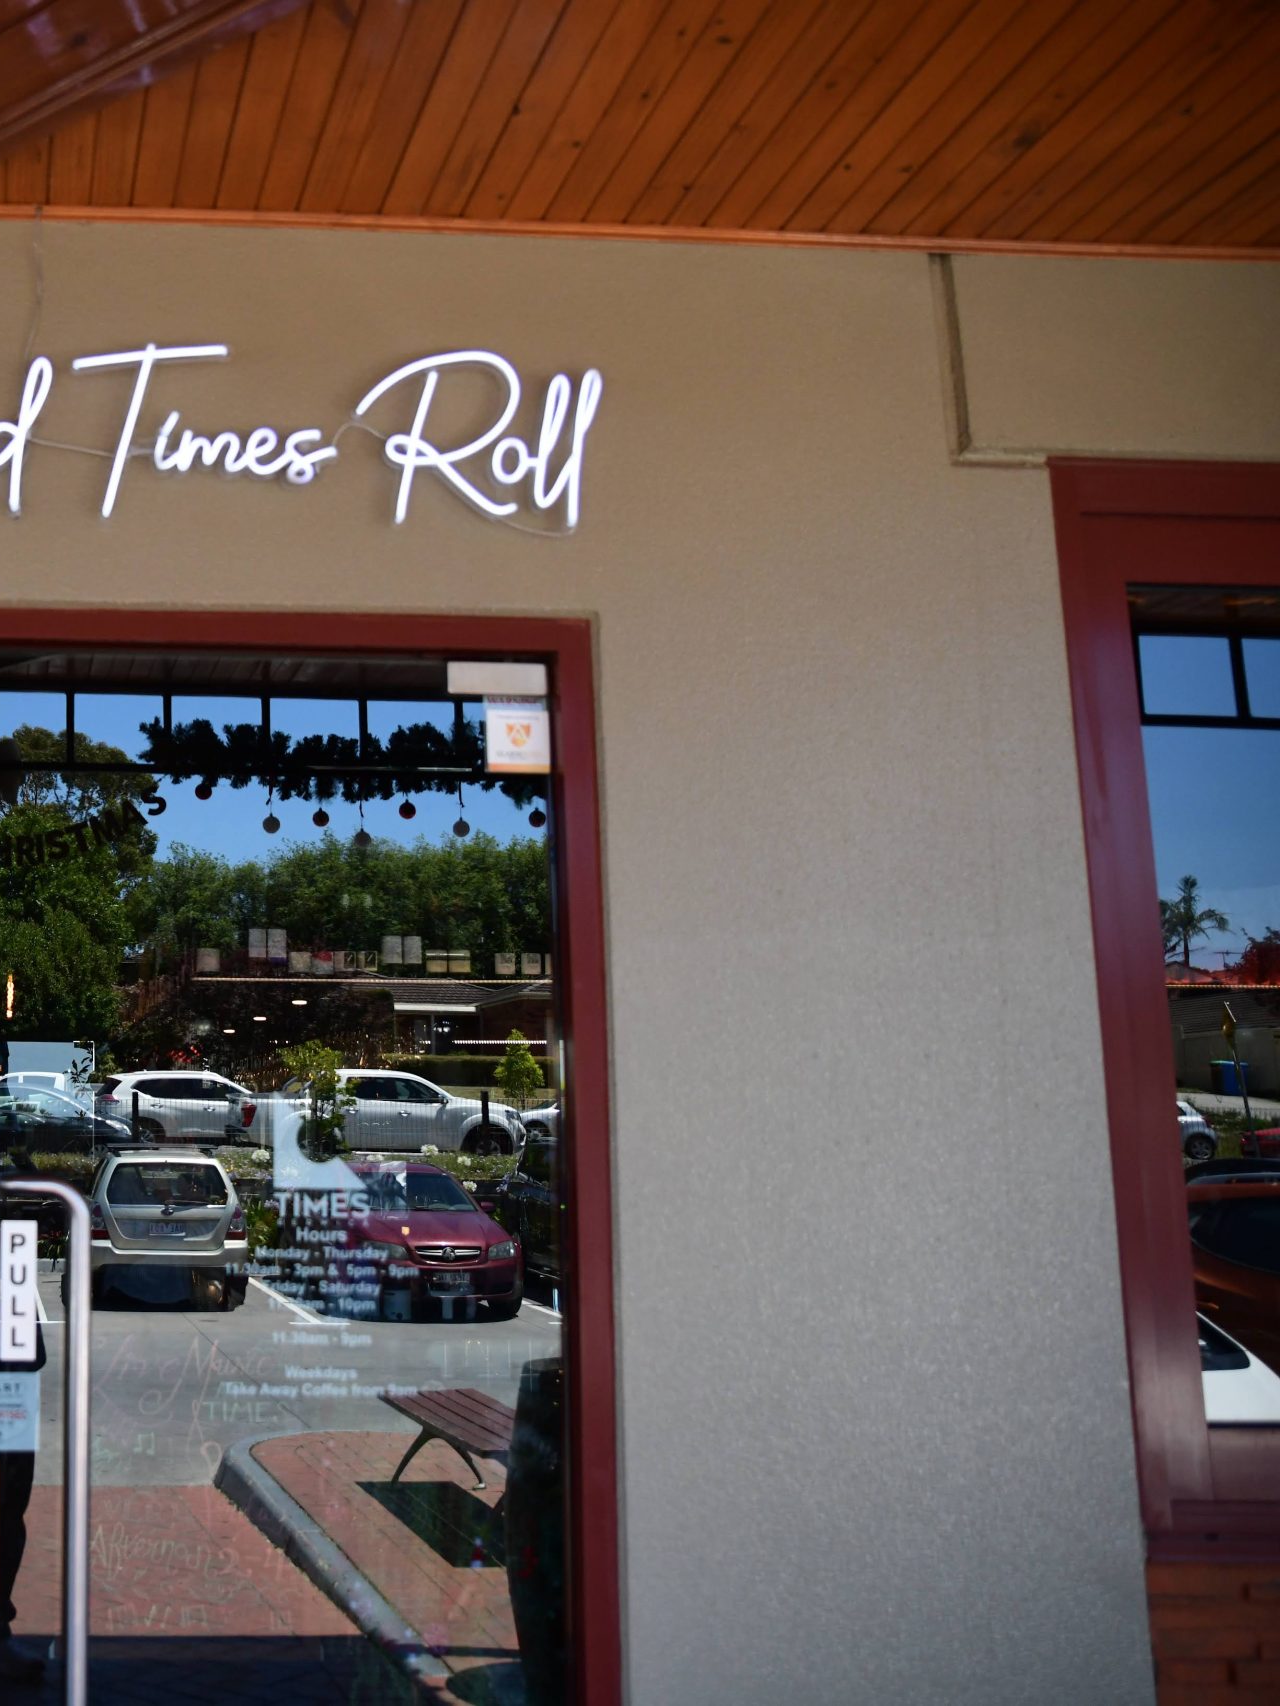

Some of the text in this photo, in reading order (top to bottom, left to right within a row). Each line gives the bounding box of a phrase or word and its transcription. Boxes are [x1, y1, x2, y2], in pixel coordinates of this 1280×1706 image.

[72, 342, 338, 519] Times
[355, 350, 602, 527] Roll
[272, 1191, 370, 1219] TIMES
[295, 1227, 348, 1243] Hours
[254, 1246, 311, 1260] Monday
[324, 1246, 389, 1262] Thursday
[328, 1263, 339, 1275] &
[9, 1234, 27, 1347] PULL
[266, 1280, 306, 1295] Friday
[318, 1280, 381, 1298] Saturday
[284, 1365, 359, 1381] Weekdays
[226, 1382, 257, 1397] Take
[259, 1383, 299, 1398] Away
[301, 1382, 349, 1397] Coffee
[351, 1383, 386, 1397] from
